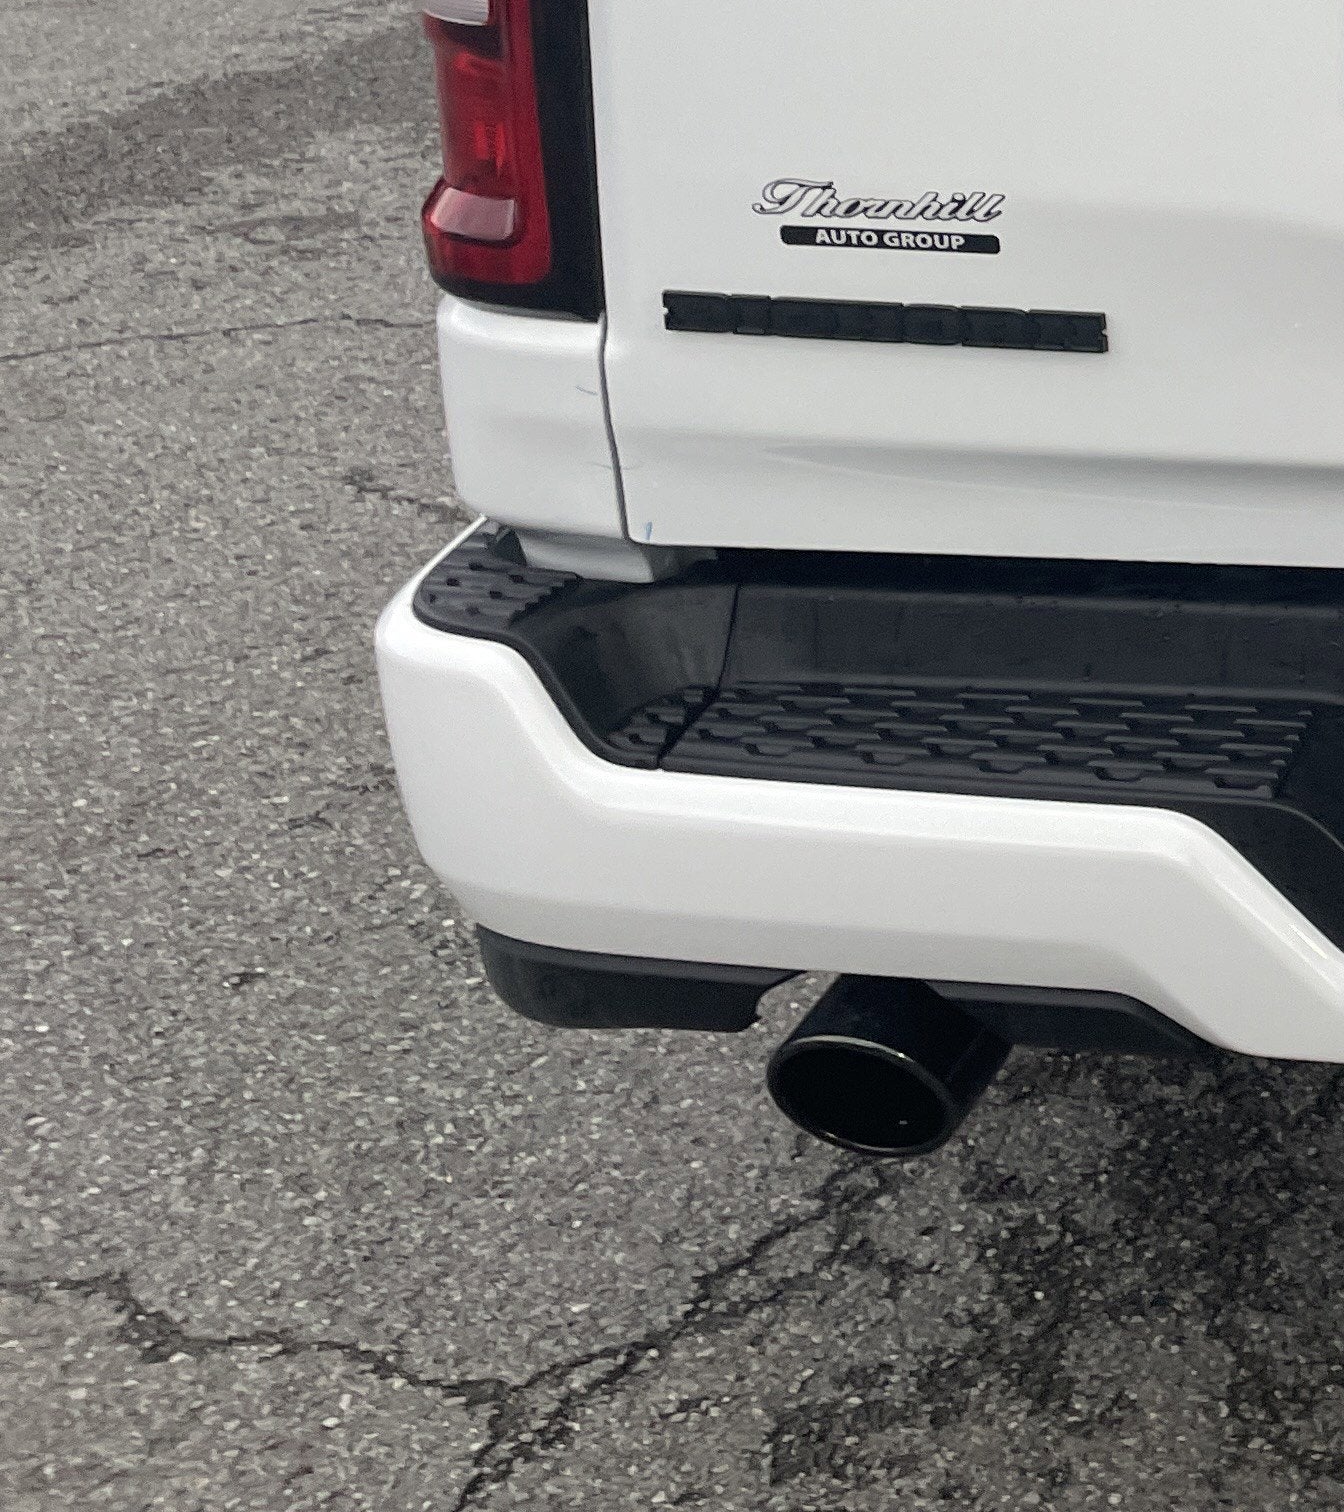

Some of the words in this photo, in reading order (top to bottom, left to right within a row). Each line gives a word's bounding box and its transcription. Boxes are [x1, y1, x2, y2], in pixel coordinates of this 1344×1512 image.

[752, 178, 1006, 222] Thornhill
[815, 229, 879, 246] AUTO
[883, 232, 966, 250] GROUP
